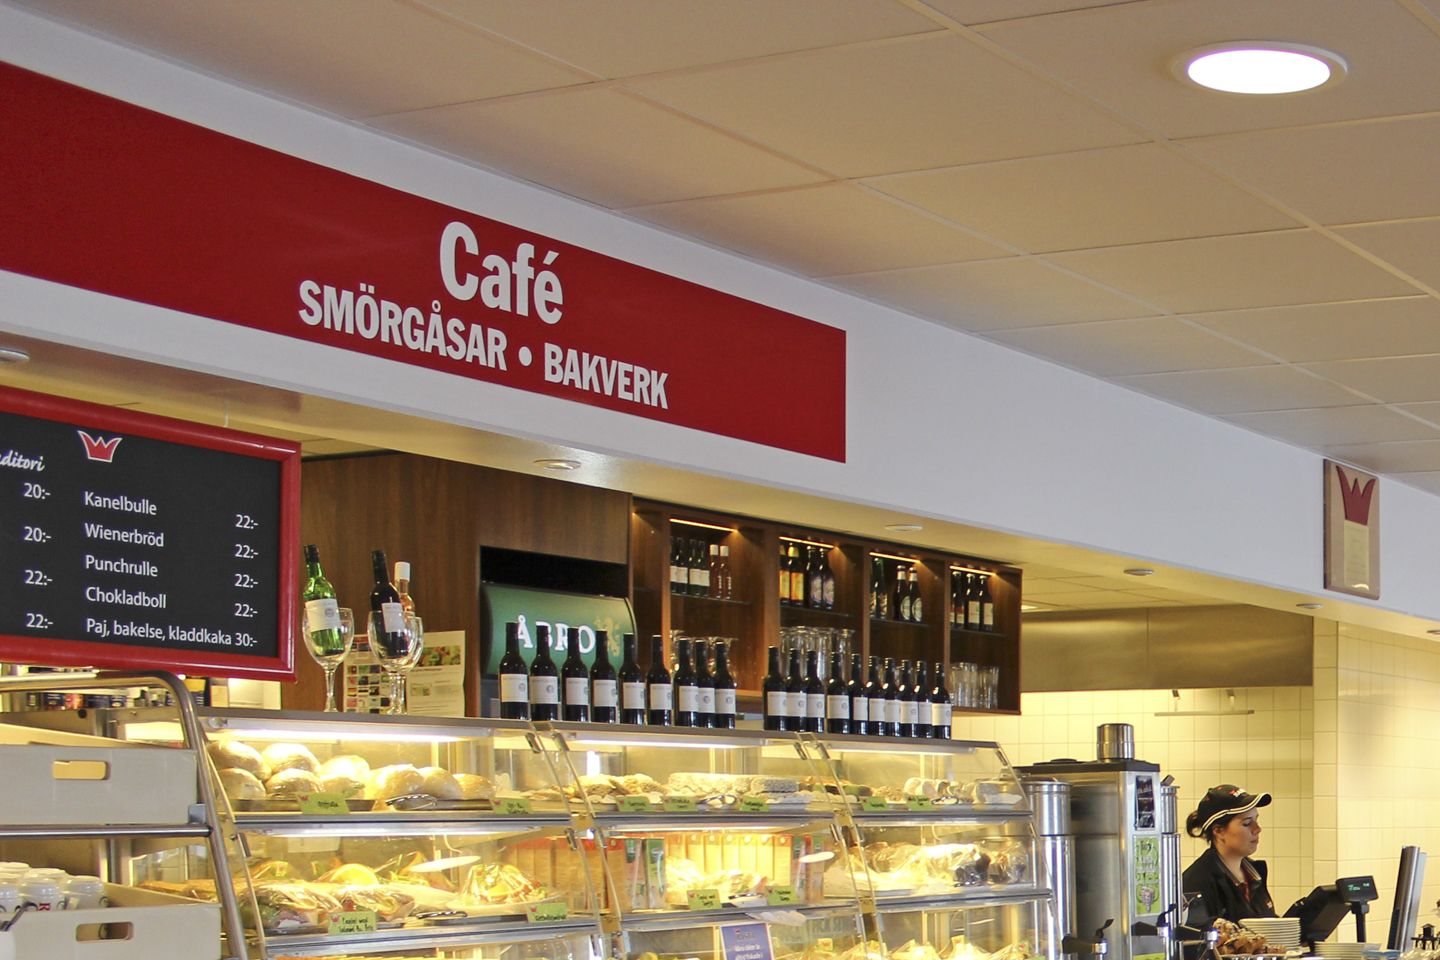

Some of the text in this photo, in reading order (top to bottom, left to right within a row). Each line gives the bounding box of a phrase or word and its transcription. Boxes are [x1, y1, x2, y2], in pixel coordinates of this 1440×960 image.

[440, 221, 564, 325] Café
[298, 279, 668, 410] SMÖRGÅSAR BAKVERK
[0, 450, 45, 472] ditori
[23, 482, 51, 500] 20:-
[84, 490, 157, 516] Kanelbulle
[235, 513, 259, 530] 22:-
[23, 525, 52, 543] 20:-
[84, 522, 164, 547] Wienerbröd
[234, 543, 259, 559] 22:-
[85, 554, 158, 577] Punchrulle
[24, 569, 53, 586] 22:-
[234, 573, 259, 589] 22:-
[85, 586, 167, 609] Chokladboll
[234, 602, 258, 618] 22:-
[26, 612, 54, 629] 22:-
[86, 617, 258, 647] Paj, bakelse, kladdkaka 30:-
